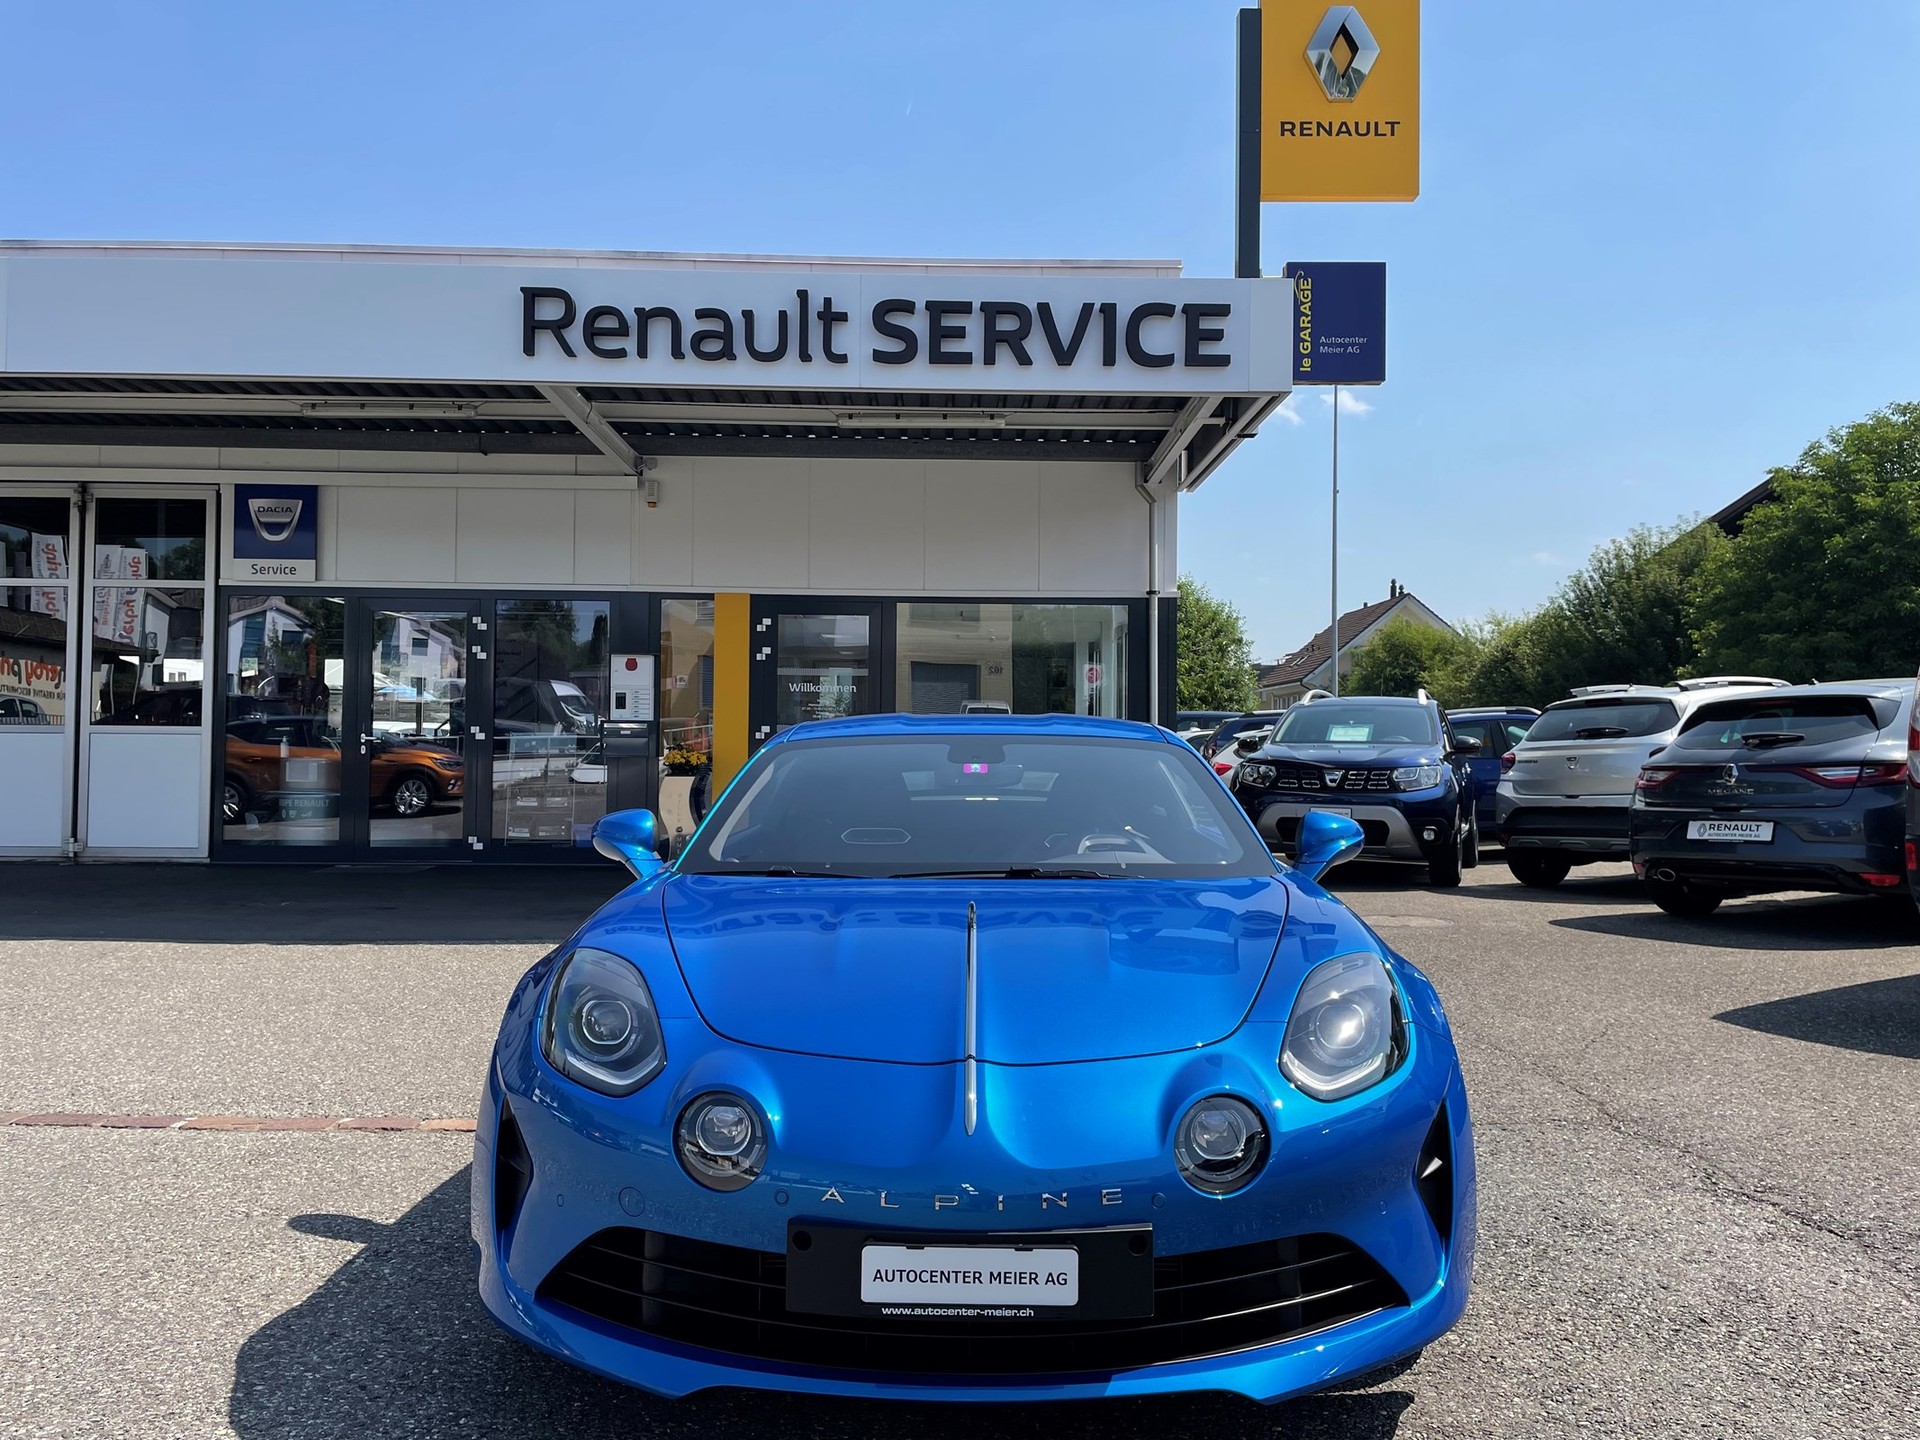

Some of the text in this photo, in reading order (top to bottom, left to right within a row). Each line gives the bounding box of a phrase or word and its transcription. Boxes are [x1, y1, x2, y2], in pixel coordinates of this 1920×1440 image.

[1280, 121, 1400, 137] RENAULT
[519, 286, 1232, 369] Renault SERVICE
[1299, 277, 1312, 372] le GARAGE
[1319, 336, 1368, 344] Autocenter
[1319, 346, 1360, 354] Meier AG
[257, 506, 293, 514] DACIA
[251, 563, 297, 576] Service
[788, 682, 857, 693] Willkommen
[1708, 823, 1762, 832] RENAULT
[821, 1186, 1123, 1211] ALPINE
[873, 1268, 1068, 1287] AUTOCENTER MEIER AG
[881, 1306, 1035, 1318] www.autocenter-meier.ch
